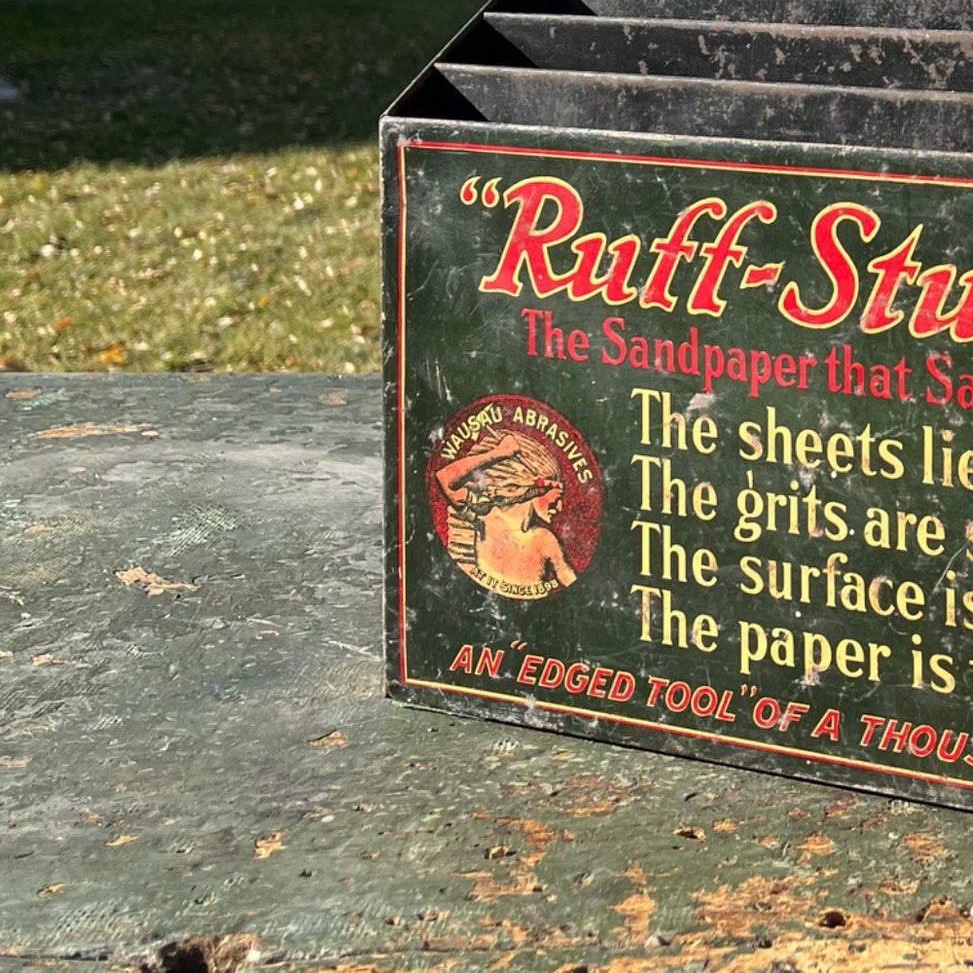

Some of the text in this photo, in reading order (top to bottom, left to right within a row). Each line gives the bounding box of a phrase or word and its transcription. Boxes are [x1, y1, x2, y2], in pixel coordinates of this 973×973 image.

[520, 308, 590, 362] The
[601, 316, 818, 398] Sandpaper
[825, 344, 913, 402] that
[441, 405, 594, 485] WAUSAU ABRASIVES
[630, 387, 719, 455] The
[738, 405, 905, 480] sheets
[630, 454, 719, 521] The
[733, 469, 849, 543] grits
[863, 506, 946, 557] are
[630, 520, 719, 588] The
[738, 552, 926, 621] surface
[630, 584, 719, 653] The
[738, 618, 892, 683] paper
[911, 633, 956, 696] is
[449, 644, 504, 679] AN
[752, 696, 811, 732] OF
[810, 709, 842, 742] A
